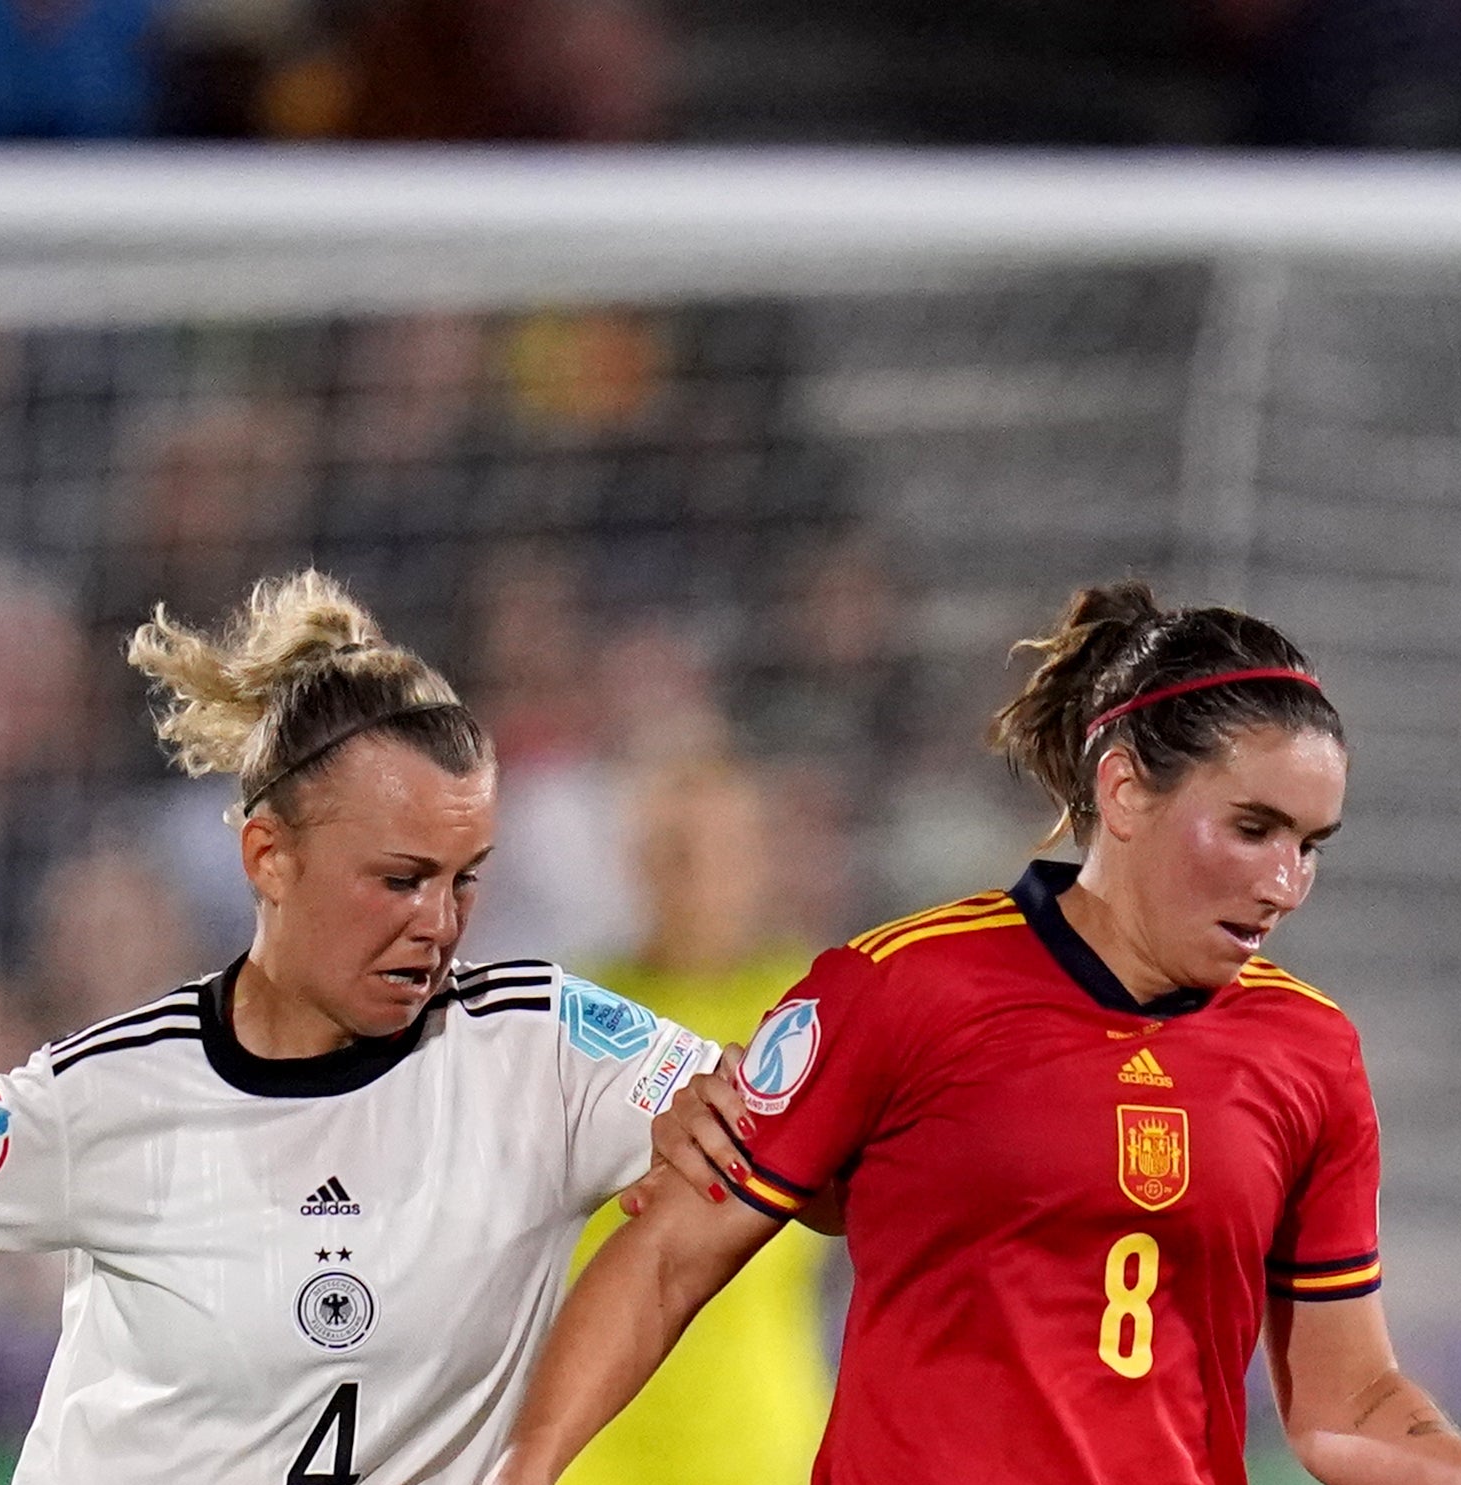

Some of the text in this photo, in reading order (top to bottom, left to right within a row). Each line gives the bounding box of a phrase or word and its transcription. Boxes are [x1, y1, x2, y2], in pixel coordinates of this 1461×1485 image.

[629, 1076, 650, 1104] UEFA
[1117, 1071, 1174, 1089] adidas
[300, 1201, 360, 1216] adidas
[1098, 1232, 1160, 1379] 8
